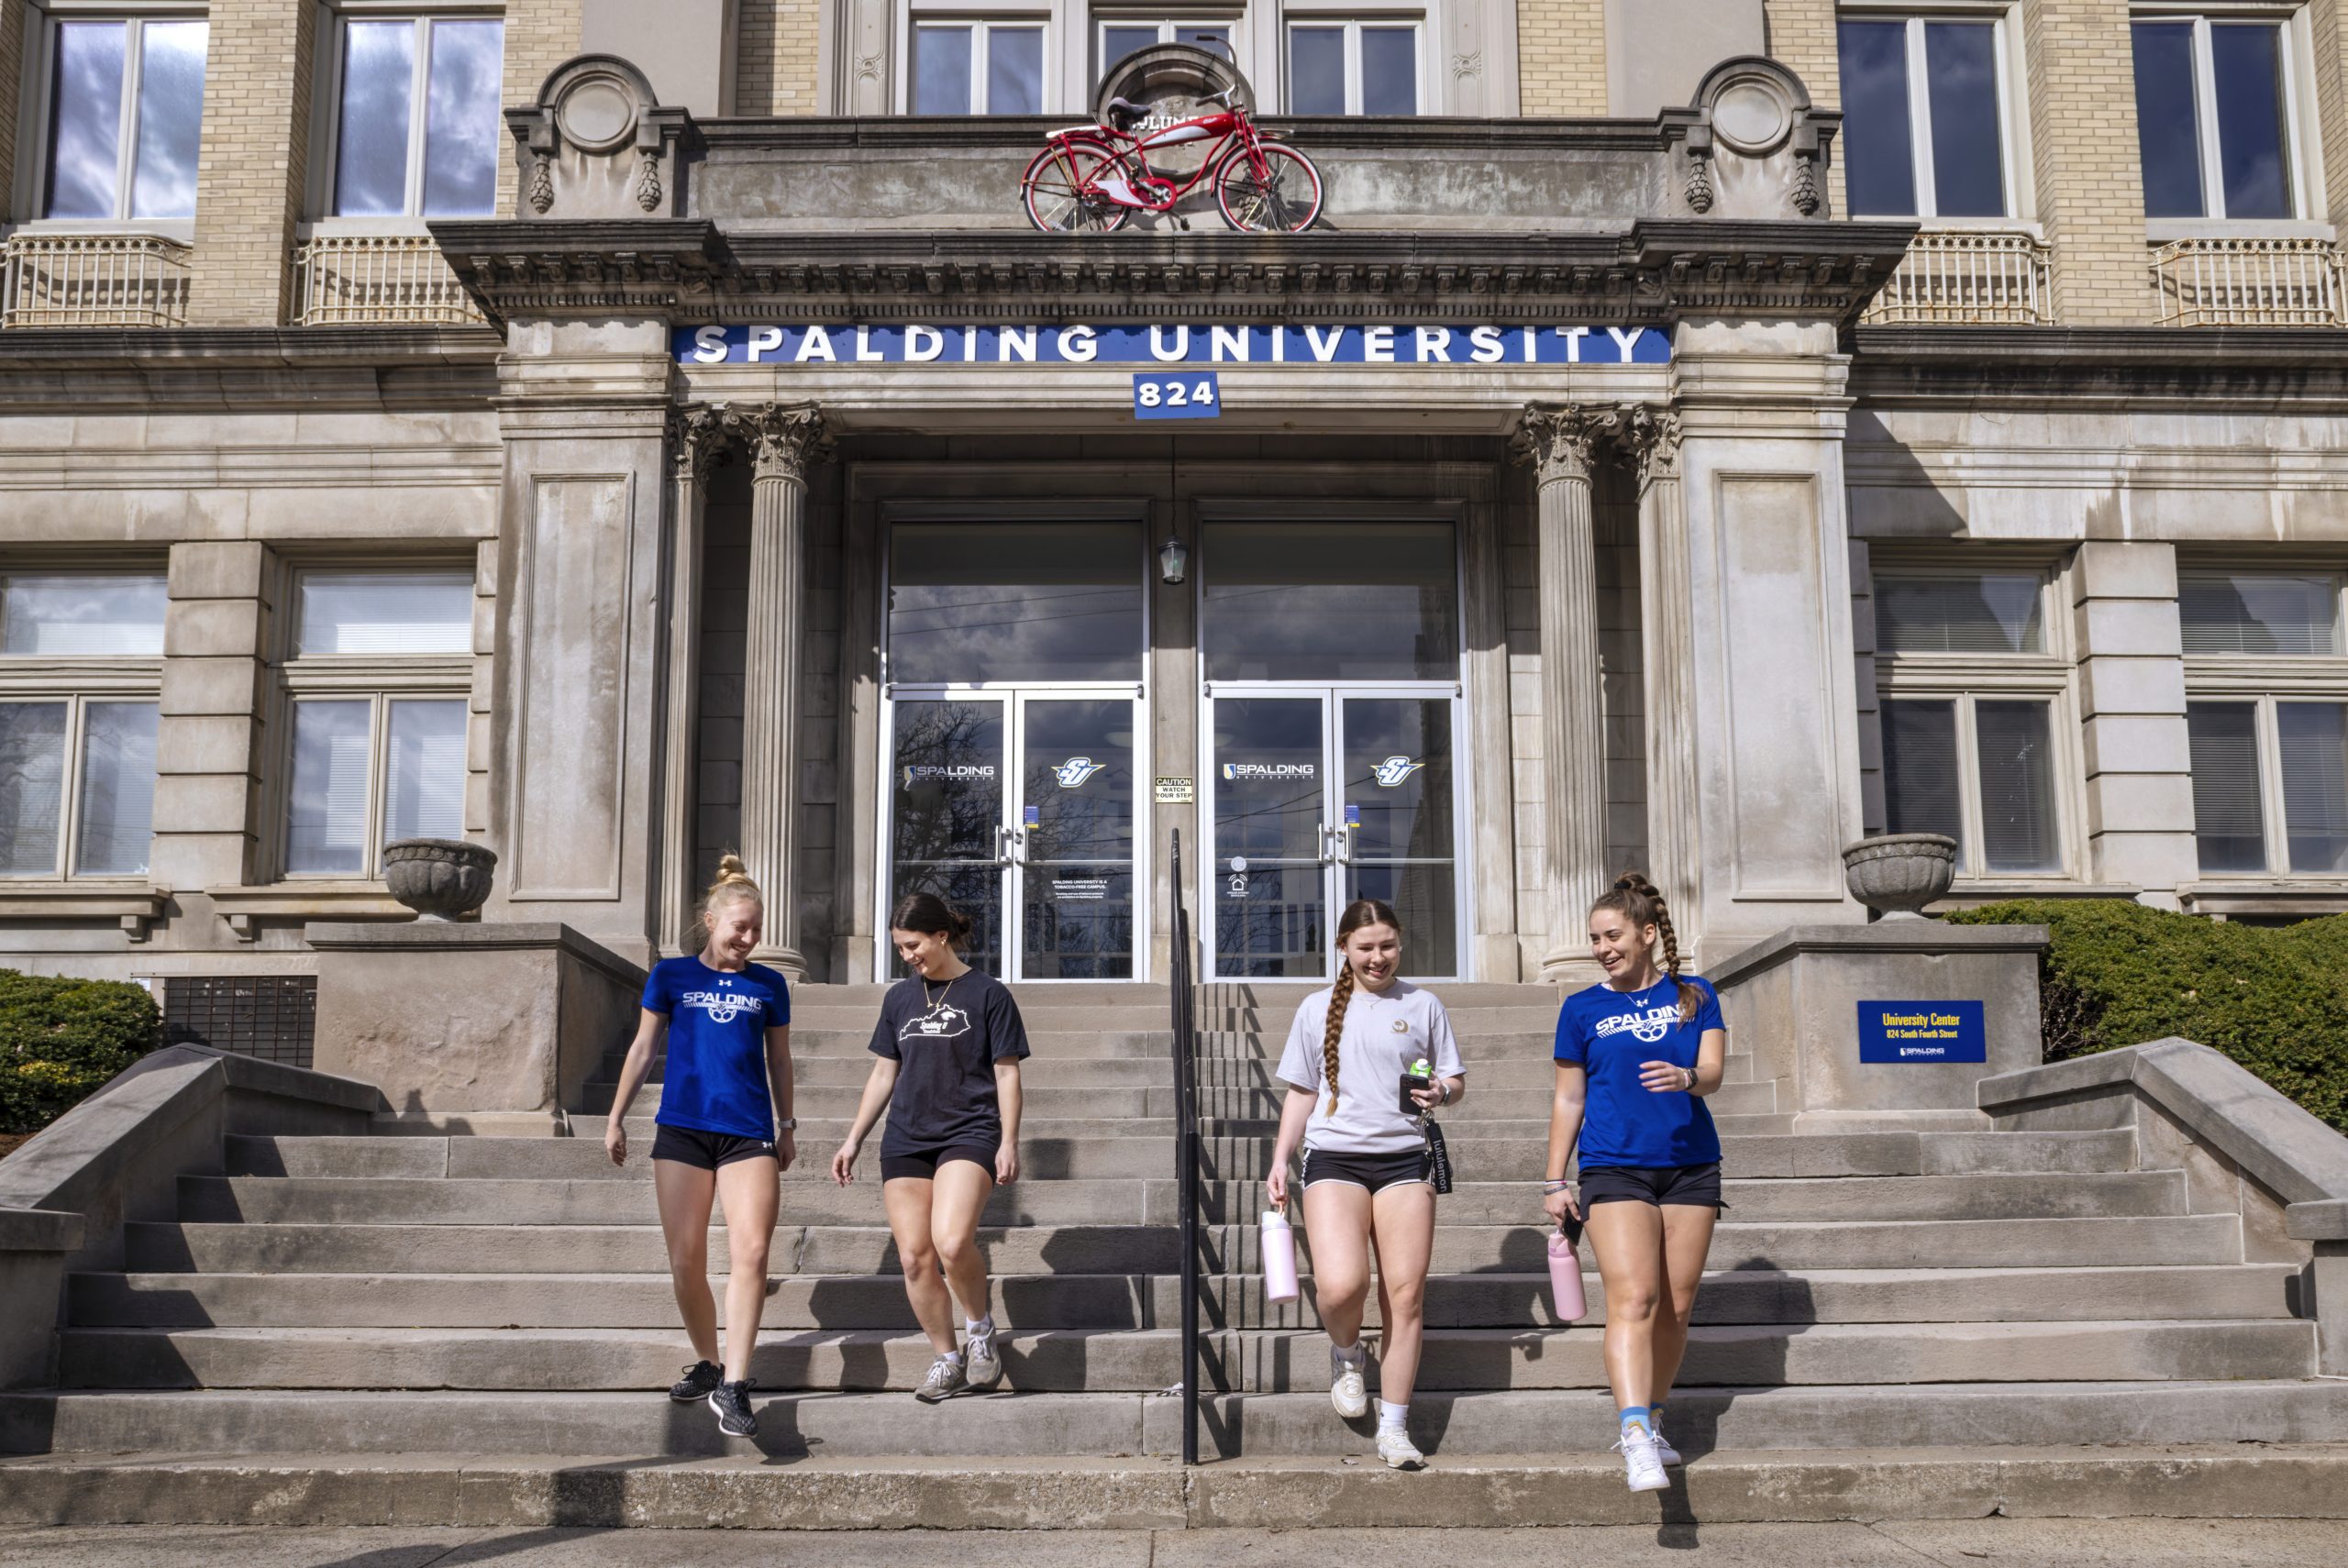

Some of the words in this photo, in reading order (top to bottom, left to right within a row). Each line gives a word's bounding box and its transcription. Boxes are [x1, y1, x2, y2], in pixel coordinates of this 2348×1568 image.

[692, 325, 1098, 363] SPALDING
[1150, 325, 1646, 363] UNIVERSITY
[1139, 381, 1214, 407] 824
[917, 766, 994, 776] SPALDING
[1236, 764, 1314, 774] SPALDING
[682, 991, 762, 1010] SPALDING
[1596, 1004, 1686, 1034] SPALDIN
[1882, 1012, 1929, 1028] University
[1931, 1012, 1960, 1026] Center
[1887, 1030, 1899, 1038] 824
[1900, 1030, 1918, 1038] South
[1919, 1030, 1938, 1038] Fourth
[1939, 1030, 1958, 1038] Street
[1433, 1139, 1448, 1193] lululemon
